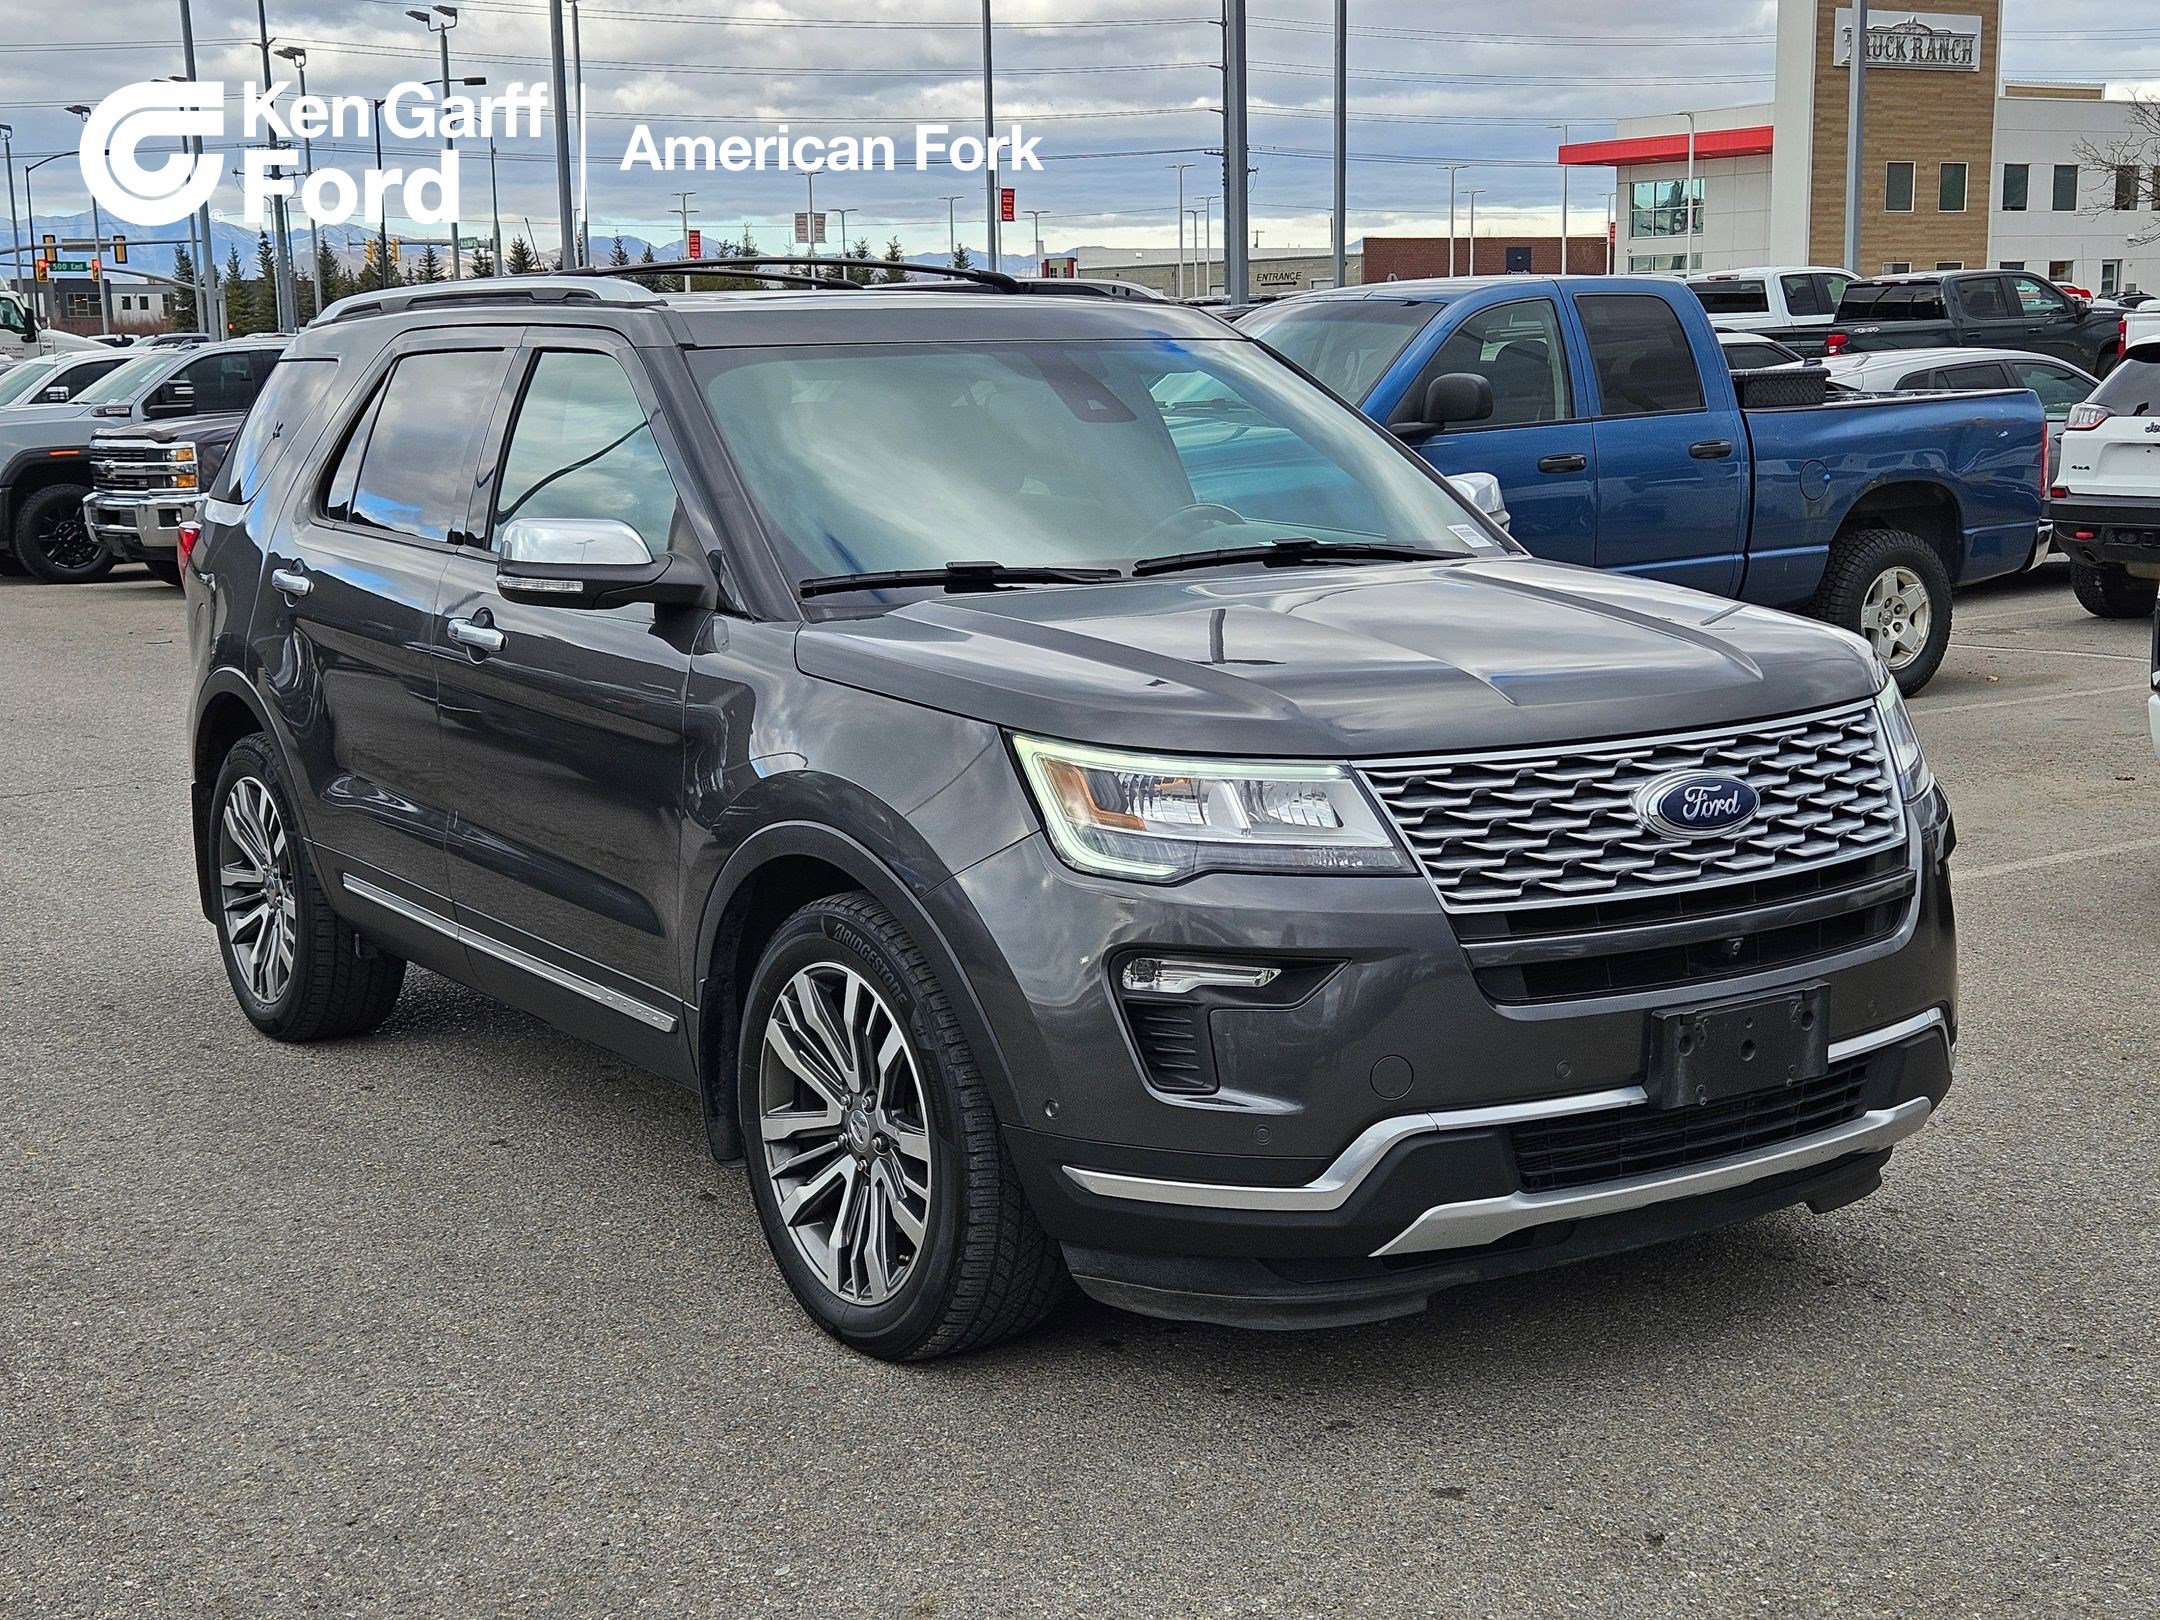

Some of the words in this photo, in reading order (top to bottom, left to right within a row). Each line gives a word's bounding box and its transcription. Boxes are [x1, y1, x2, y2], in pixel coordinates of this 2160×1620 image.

[1909, 36, 1975, 63] RANCH
[1256, 271, 1302, 282] ENTRANCE
[2145, 421, 2160, 433] Je
[1682, 784, 1741, 820] Ford
[833, 923, 908, 1004] BRIDGESTONE
